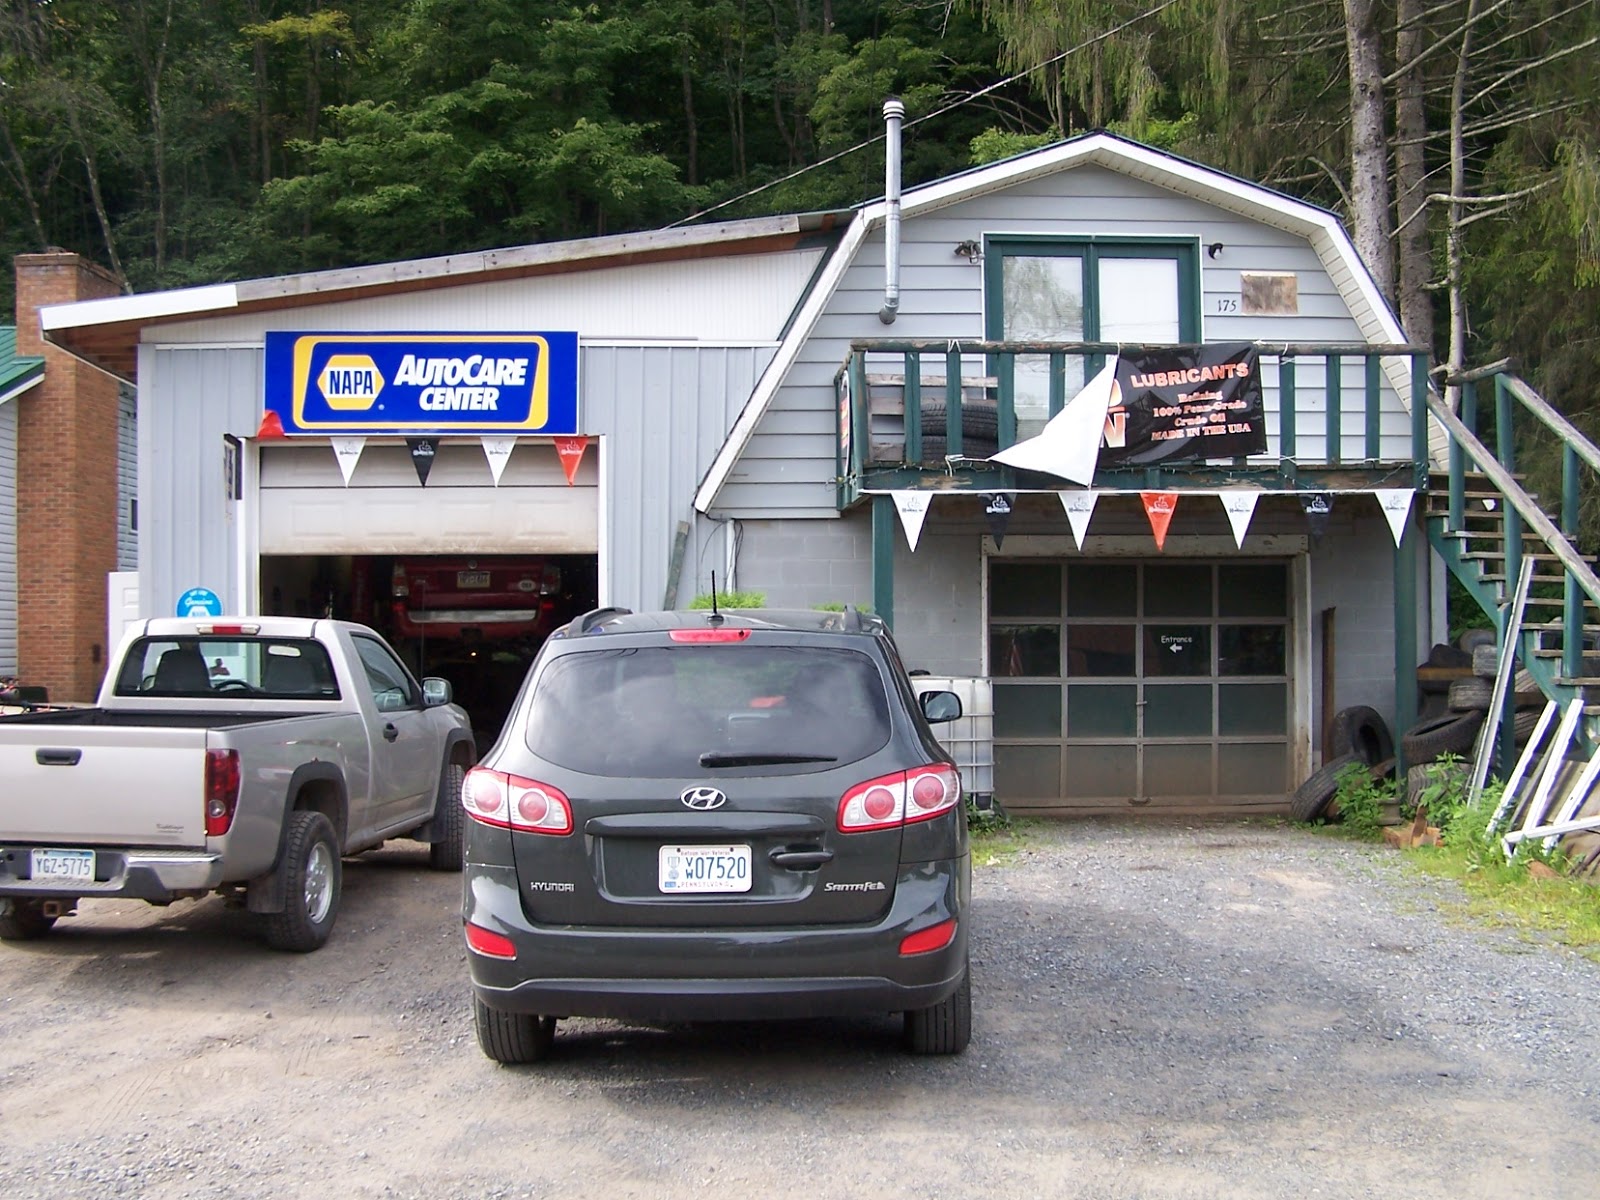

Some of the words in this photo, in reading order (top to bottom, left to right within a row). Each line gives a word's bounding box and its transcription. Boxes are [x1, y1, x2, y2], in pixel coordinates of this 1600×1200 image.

[1218, 300, 1237, 312] 175
[393, 354, 529, 386] AUTOCARE
[1130, 362, 1249, 388] LUBRICANTS
[329, 370, 374, 395] NAPA
[418, 387, 500, 411] CENTER
[1153, 406, 1182, 417] 100%
[1174, 415, 1208, 427] Crude
[1209, 413, 1226, 422] Oil
[1151, 429, 1184, 441] MADE
[1186, 427, 1200, 437] IN
[1202, 425, 1226, 436] THE
[1228, 423, 1252, 433] USA
[1160, 635, 1192, 644] Entrance
[36, 858, 91, 875] YGZ-5775
[530, 882, 575, 892] HYUNDAI
